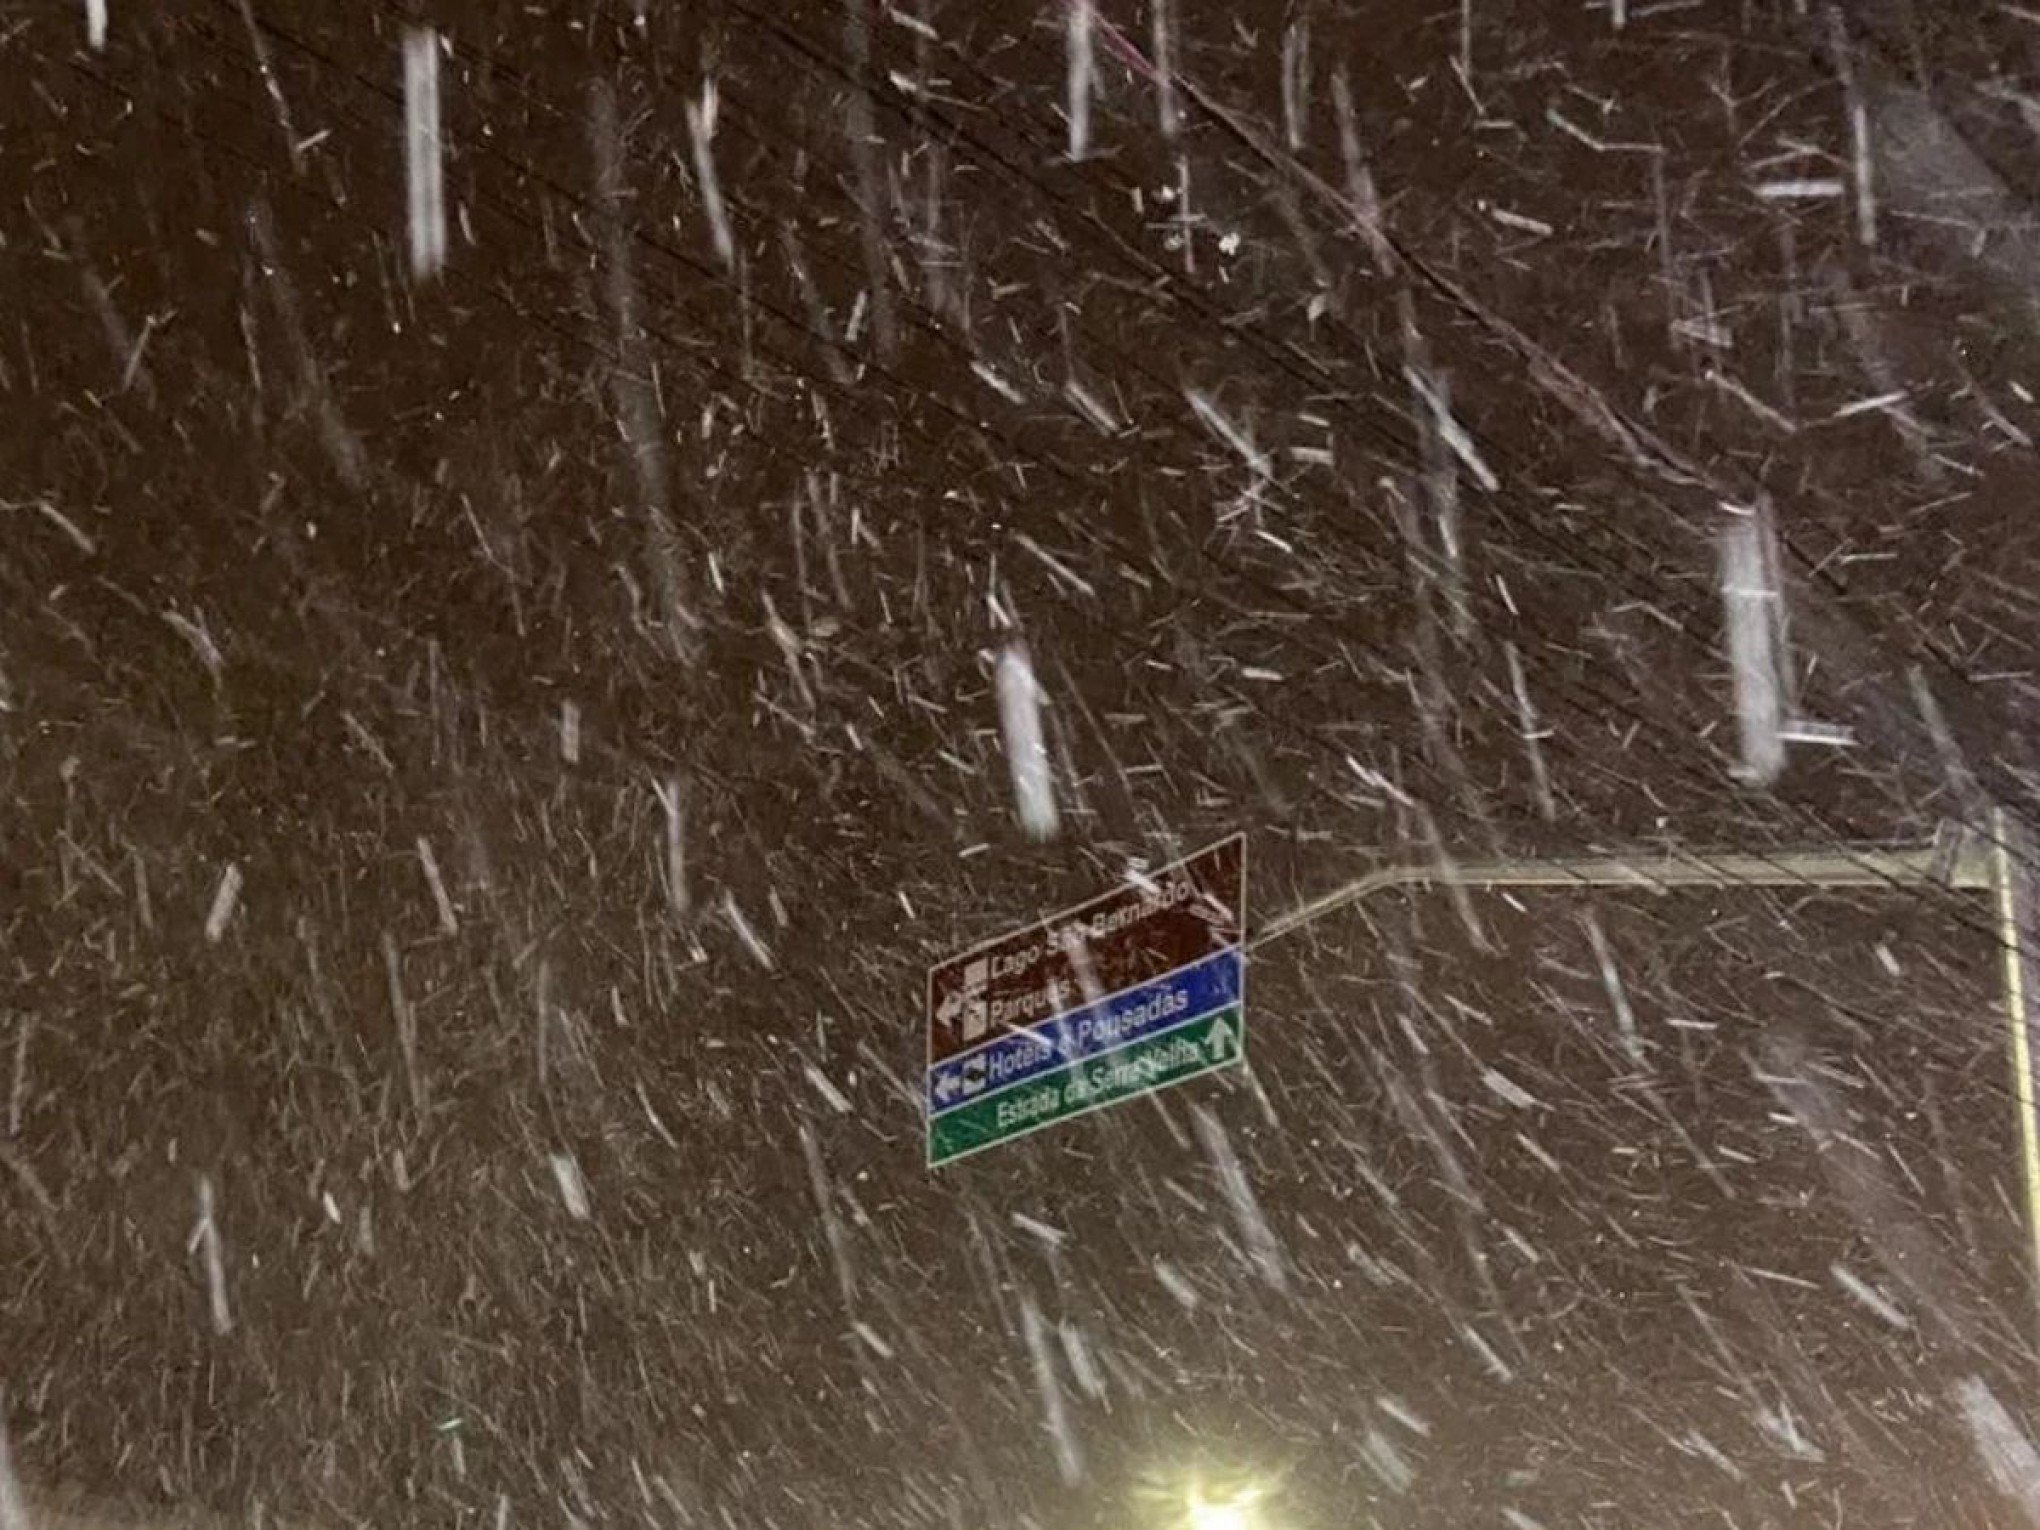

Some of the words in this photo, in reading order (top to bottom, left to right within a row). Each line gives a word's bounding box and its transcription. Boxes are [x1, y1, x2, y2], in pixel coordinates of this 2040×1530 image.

[993, 945, 1039, 976] Lago
[991, 978, 1070, 1026] Parqus
[1079, 990, 1189, 1050] Pousadas
